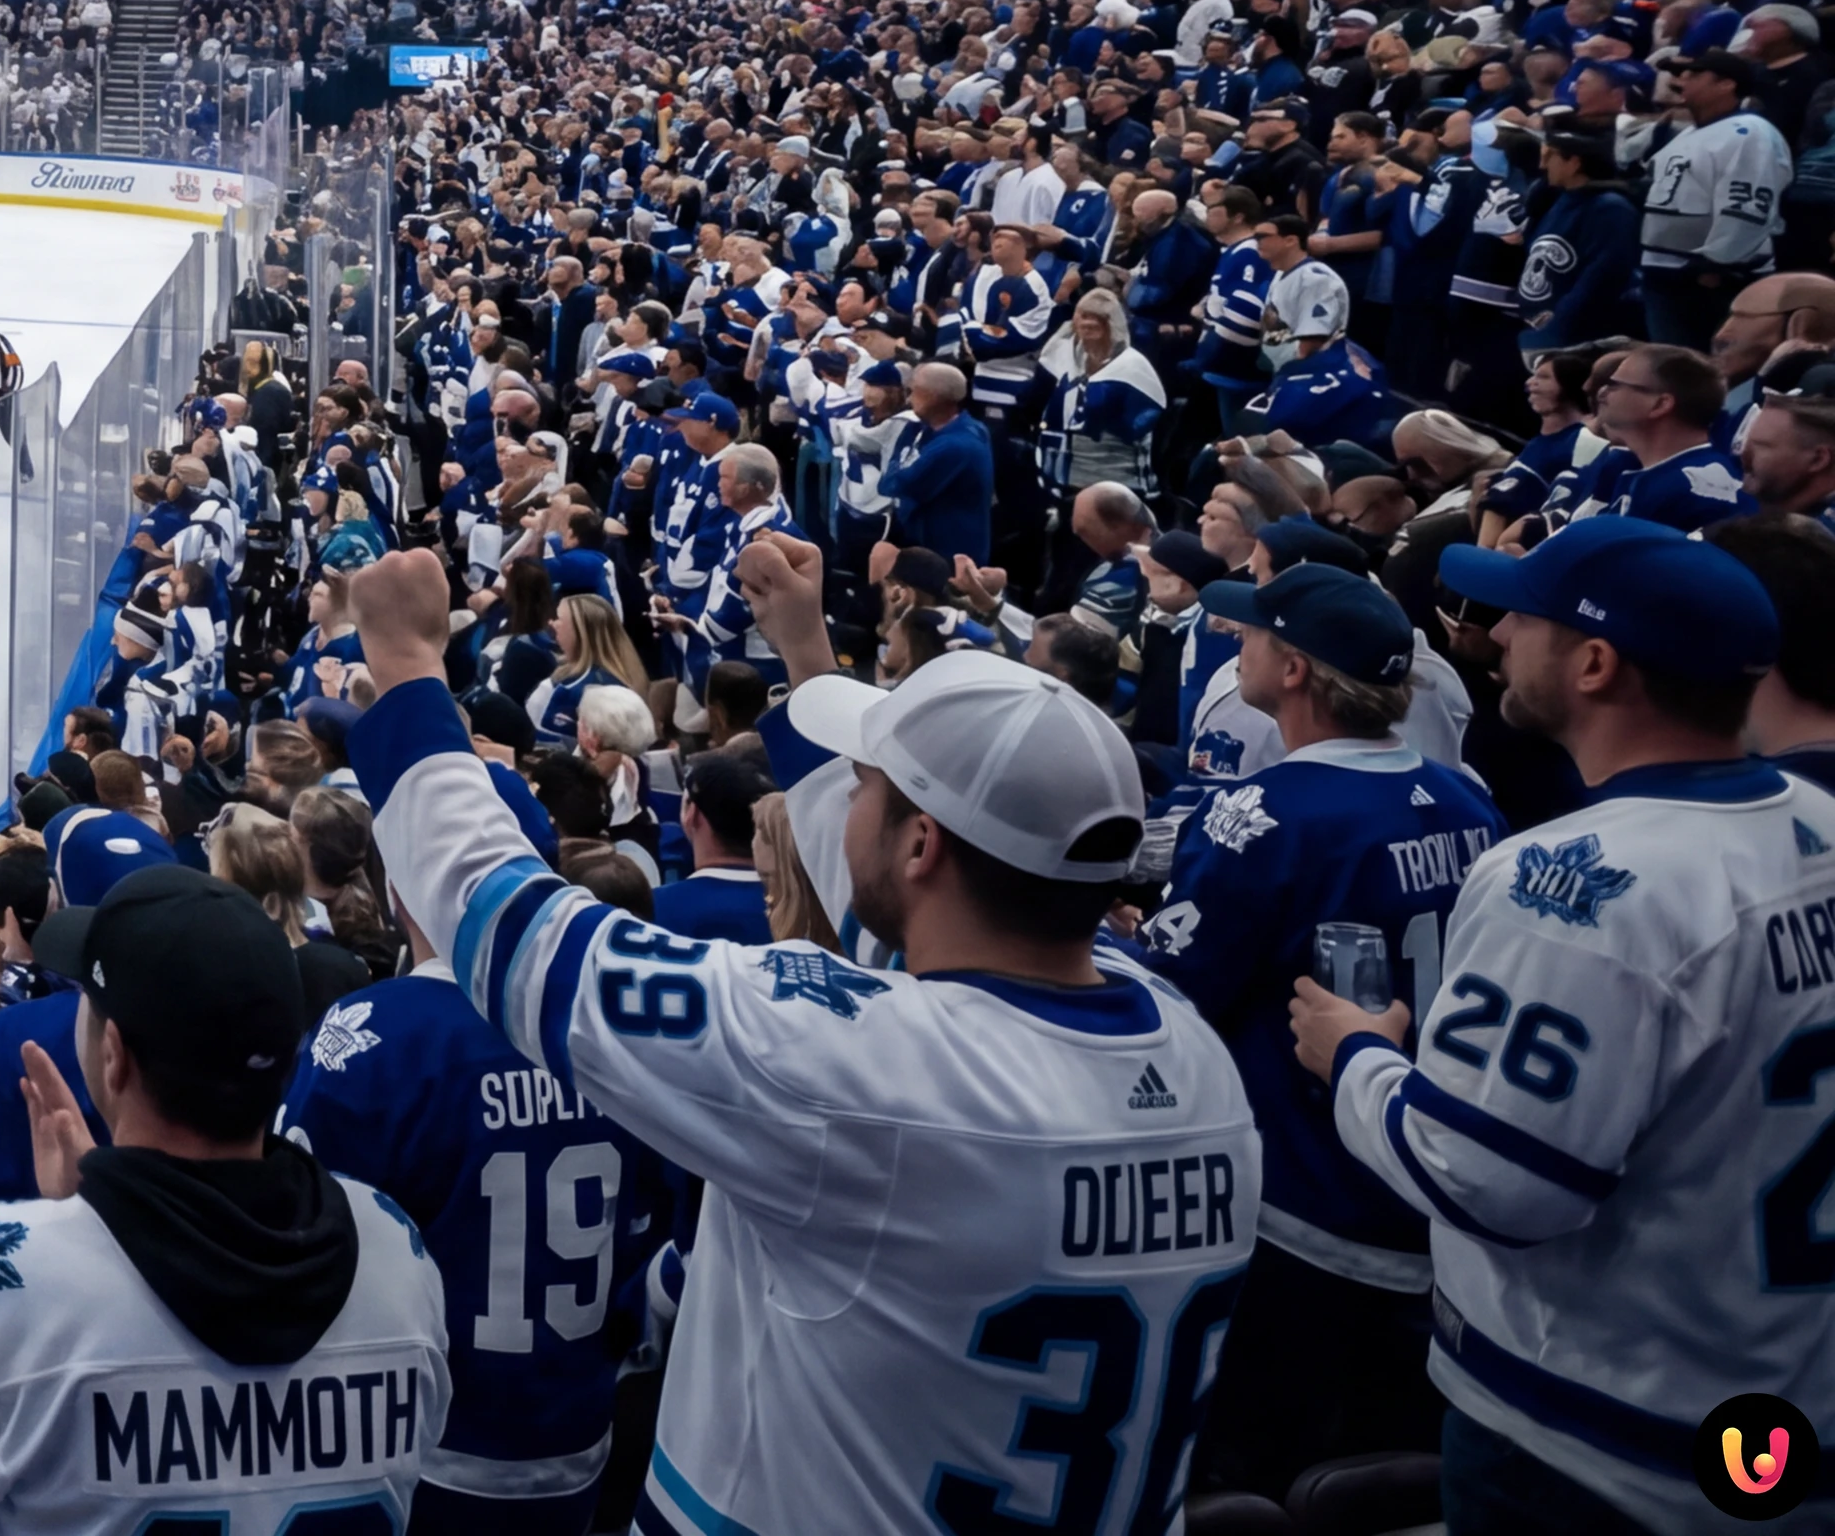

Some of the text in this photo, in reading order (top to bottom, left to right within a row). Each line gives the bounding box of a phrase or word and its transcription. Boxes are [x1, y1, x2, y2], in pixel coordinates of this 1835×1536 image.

[1431, 971, 1591, 1106] 26
[473, 1141, 623, 1353] 19
[93, 1367, 418, 1486] MAMMOTH
